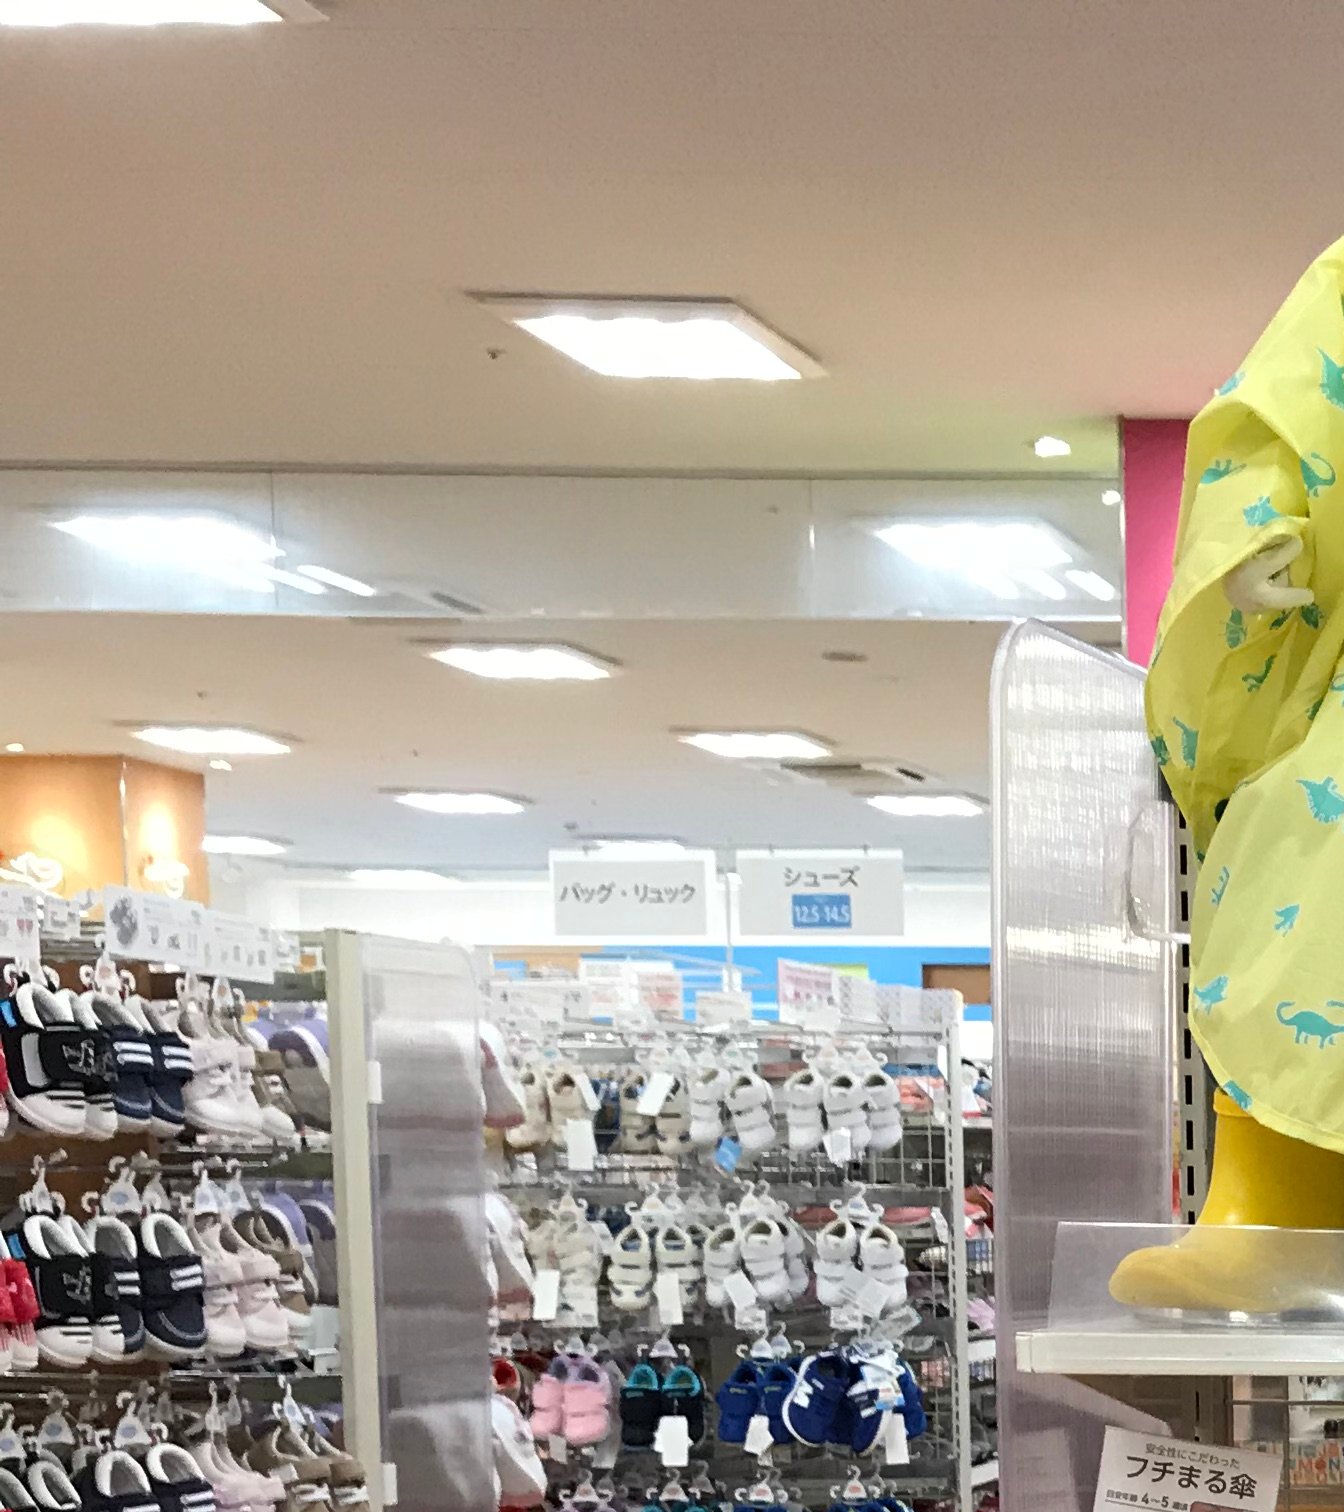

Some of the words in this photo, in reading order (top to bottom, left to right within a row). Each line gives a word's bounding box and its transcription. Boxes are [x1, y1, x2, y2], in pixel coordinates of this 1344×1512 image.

[783, 866, 860, 888] シューズ
[559, 883, 696, 904] バッグ・リュック
[1126, 1456, 1258, 1499] フチまる傘
